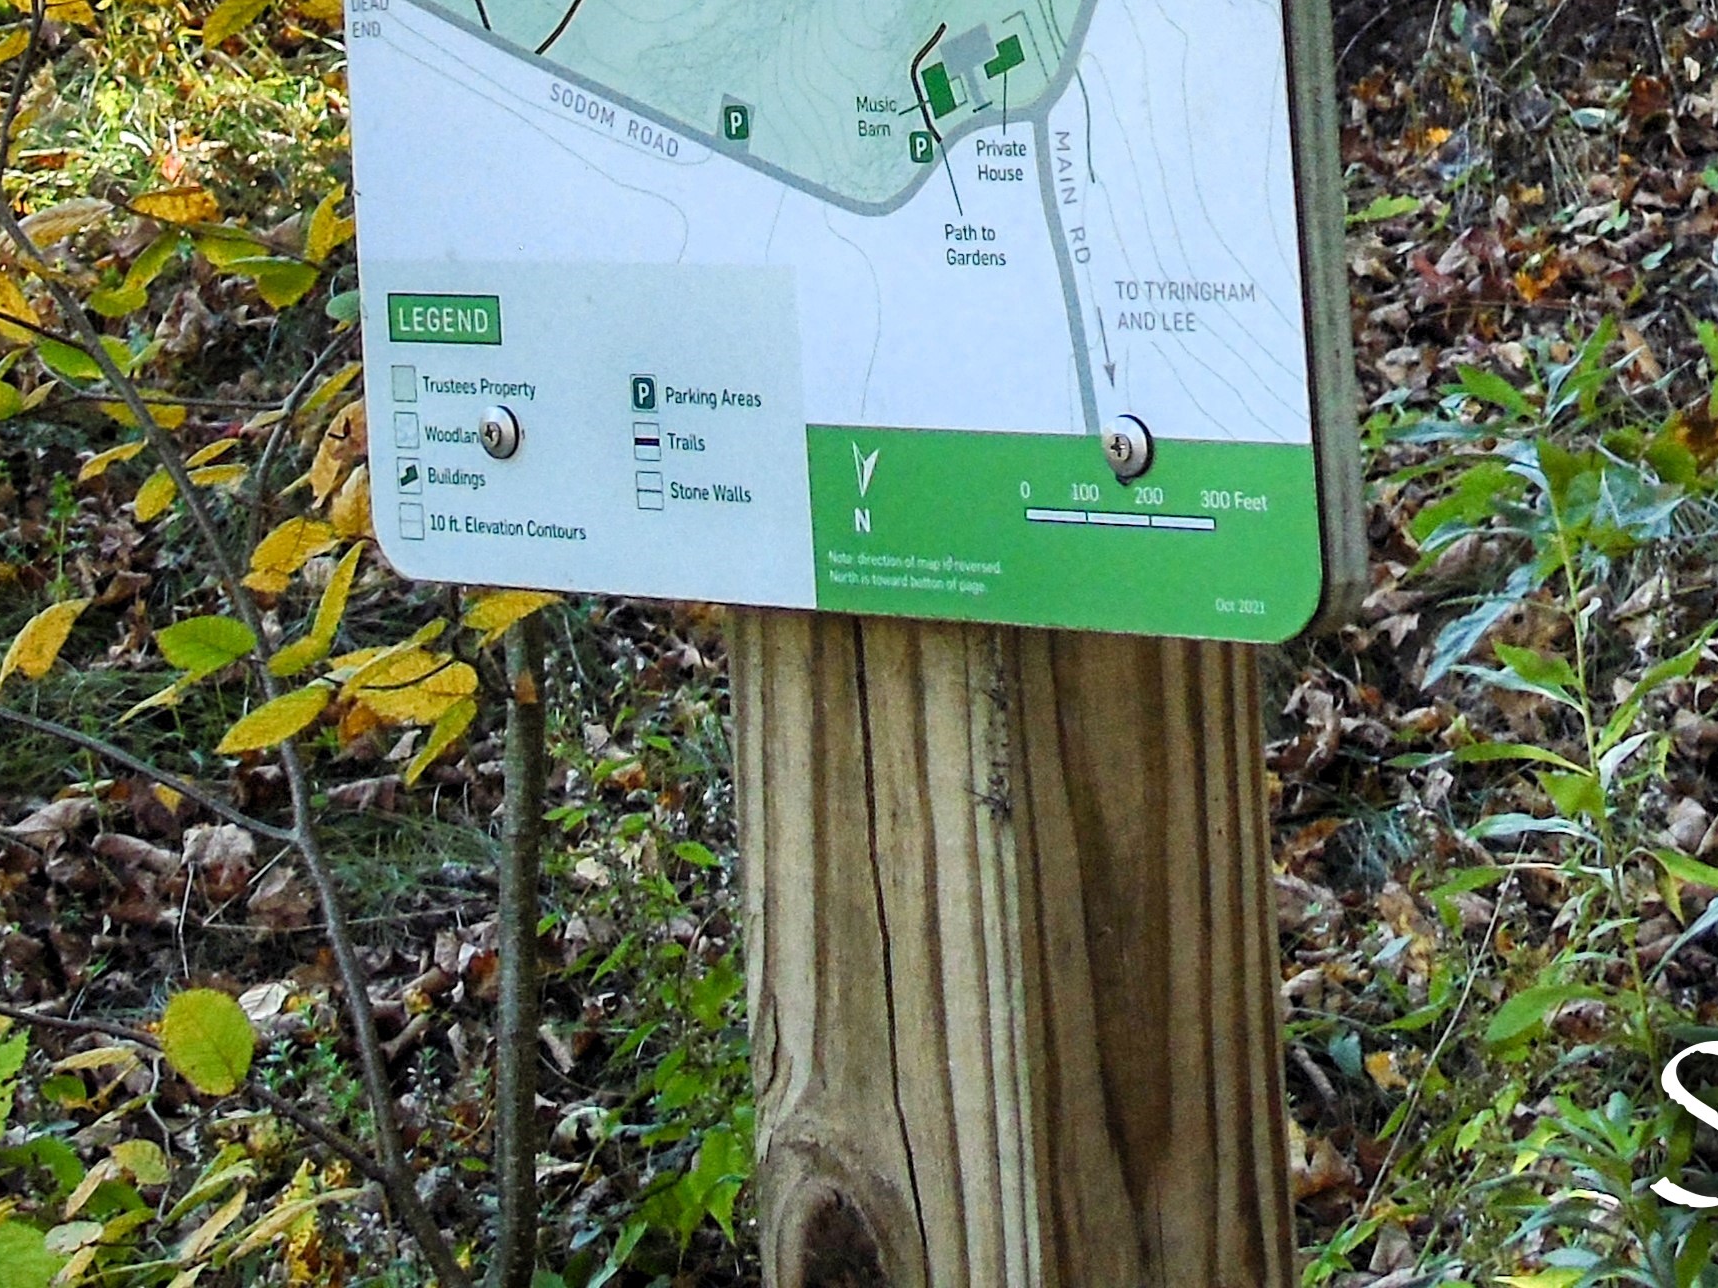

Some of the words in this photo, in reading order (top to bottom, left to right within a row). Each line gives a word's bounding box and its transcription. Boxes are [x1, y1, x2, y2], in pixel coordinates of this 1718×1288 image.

[352, 21, 382, 38] END
[856, 96, 897, 114] Music
[548, 82, 616, 128] SODOM
[627, 121, 680, 158] ROAD
[729, 111, 743, 135] P
[858, 121, 891, 137] Barn
[913, 138, 928, 158] P
[976, 140, 1027, 157] Private
[977, 165, 1024, 181] House
[1055, 131, 1078, 205] MAIN
[1069, 226, 1091, 264] RD
[944, 223, 977, 241] Path
[981, 226, 996, 241] to
[946, 248, 1007, 266] Gardens
[1115, 280, 1139, 300] TO
[1144, 280, 1256, 302] TYRINGHAM
[398, 306, 489, 333] LEGEND
[1117, 311, 1156, 331] AND
[1162, 312, 1197, 332] LEE
[422, 375, 478, 395] Trustees
[480, 377, 536, 401] Property
[638, 382, 650, 405] P
[665, 386, 718, 410] Parking
[721, 389, 762, 408] Areas
[667, 432, 706, 452] Trails
[428, 467, 486, 490] Buildings
[670, 481, 709, 501] Stone
[713, 484, 752, 503] Walls
[1020, 481, 1031, 499] 0
[1071, 484, 1099, 502] 100
[1135, 487, 1163, 505] 200
[1200, 490, 1231, 509] 300
[1234, 491, 1268, 511] Feet
[429, 514, 445, 531] 10
[465, 516, 524, 536] Elevation
[527, 520, 587, 540] Contours
[854, 507, 871, 533] N
[857, 552, 902, 567] direction
[1215, 598, 1235, 612] Oct
[1239, 600, 1265, 614] 2021
